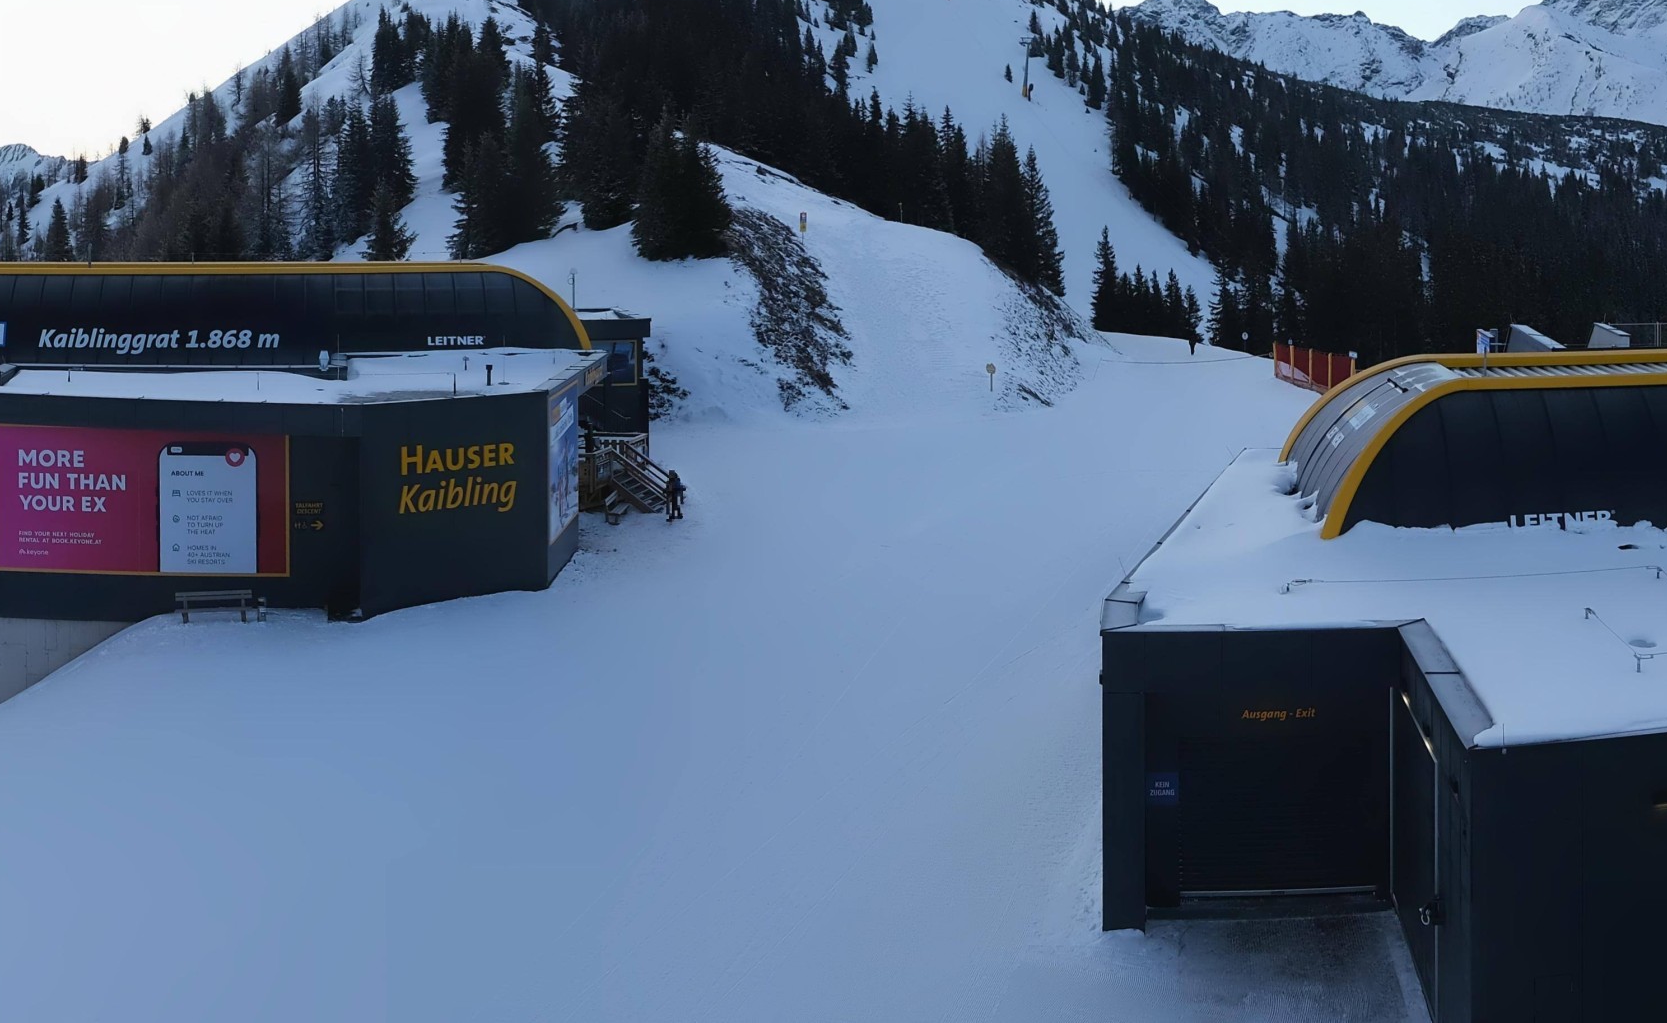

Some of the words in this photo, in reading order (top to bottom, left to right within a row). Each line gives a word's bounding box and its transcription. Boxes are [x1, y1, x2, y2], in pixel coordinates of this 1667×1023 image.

[38, 328, 180, 355] Kaiblinggrat
[185, 330, 252, 348] 1.868
[257, 333, 280, 348] m
[427, 336, 484, 346] LEITNER
[18, 449, 84, 467] MORE
[401, 442, 515, 475] HAUSER
[18, 472, 59, 489] FUN
[66, 474, 126, 490] THAN
[19, 495, 75, 511] YOUR
[81, 497, 106, 512] EX
[399, 477, 517, 514] Kaibling
[1242, 709, 1287, 721] Ausgang
[1296, 708, 1316, 718] Exit
